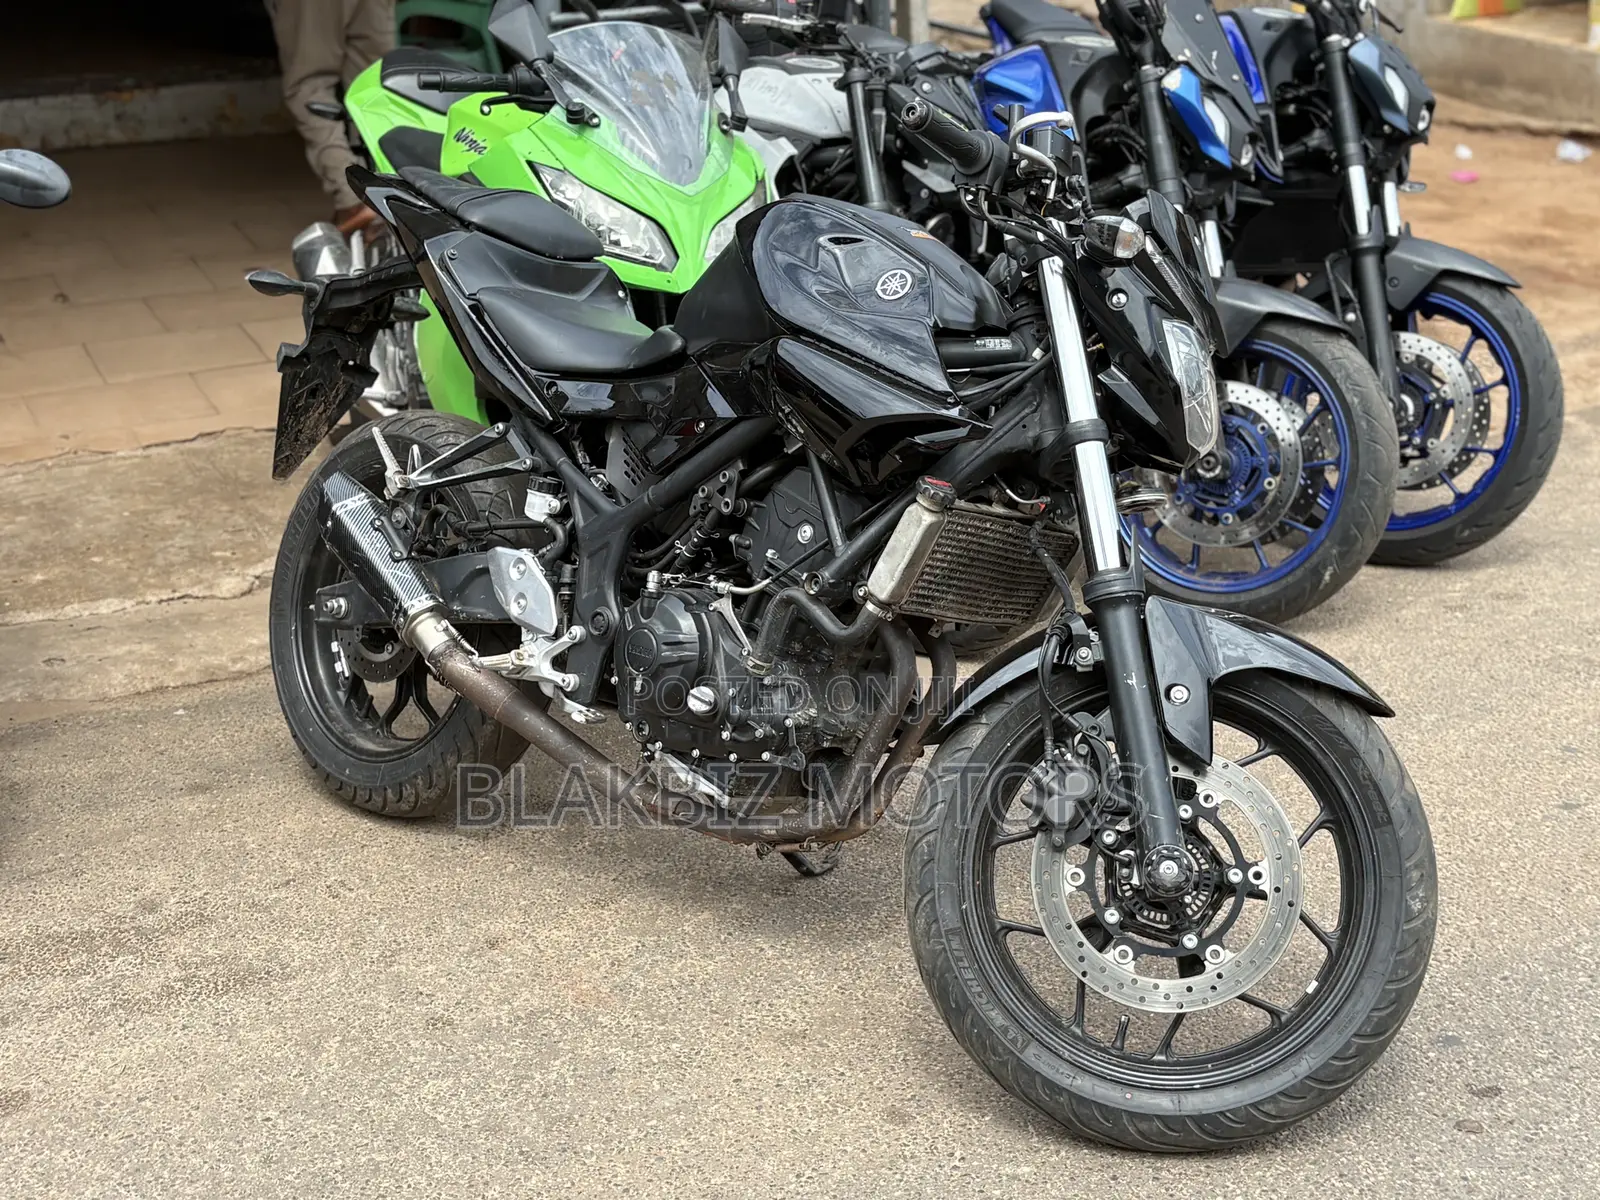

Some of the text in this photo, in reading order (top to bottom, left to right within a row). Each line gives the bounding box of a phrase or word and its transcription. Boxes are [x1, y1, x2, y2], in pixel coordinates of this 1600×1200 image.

[453, 127, 487, 155] Ninja
[1350, 756, 1390, 825] Street
[947, 932, 1007, 1029] MICHELIN
